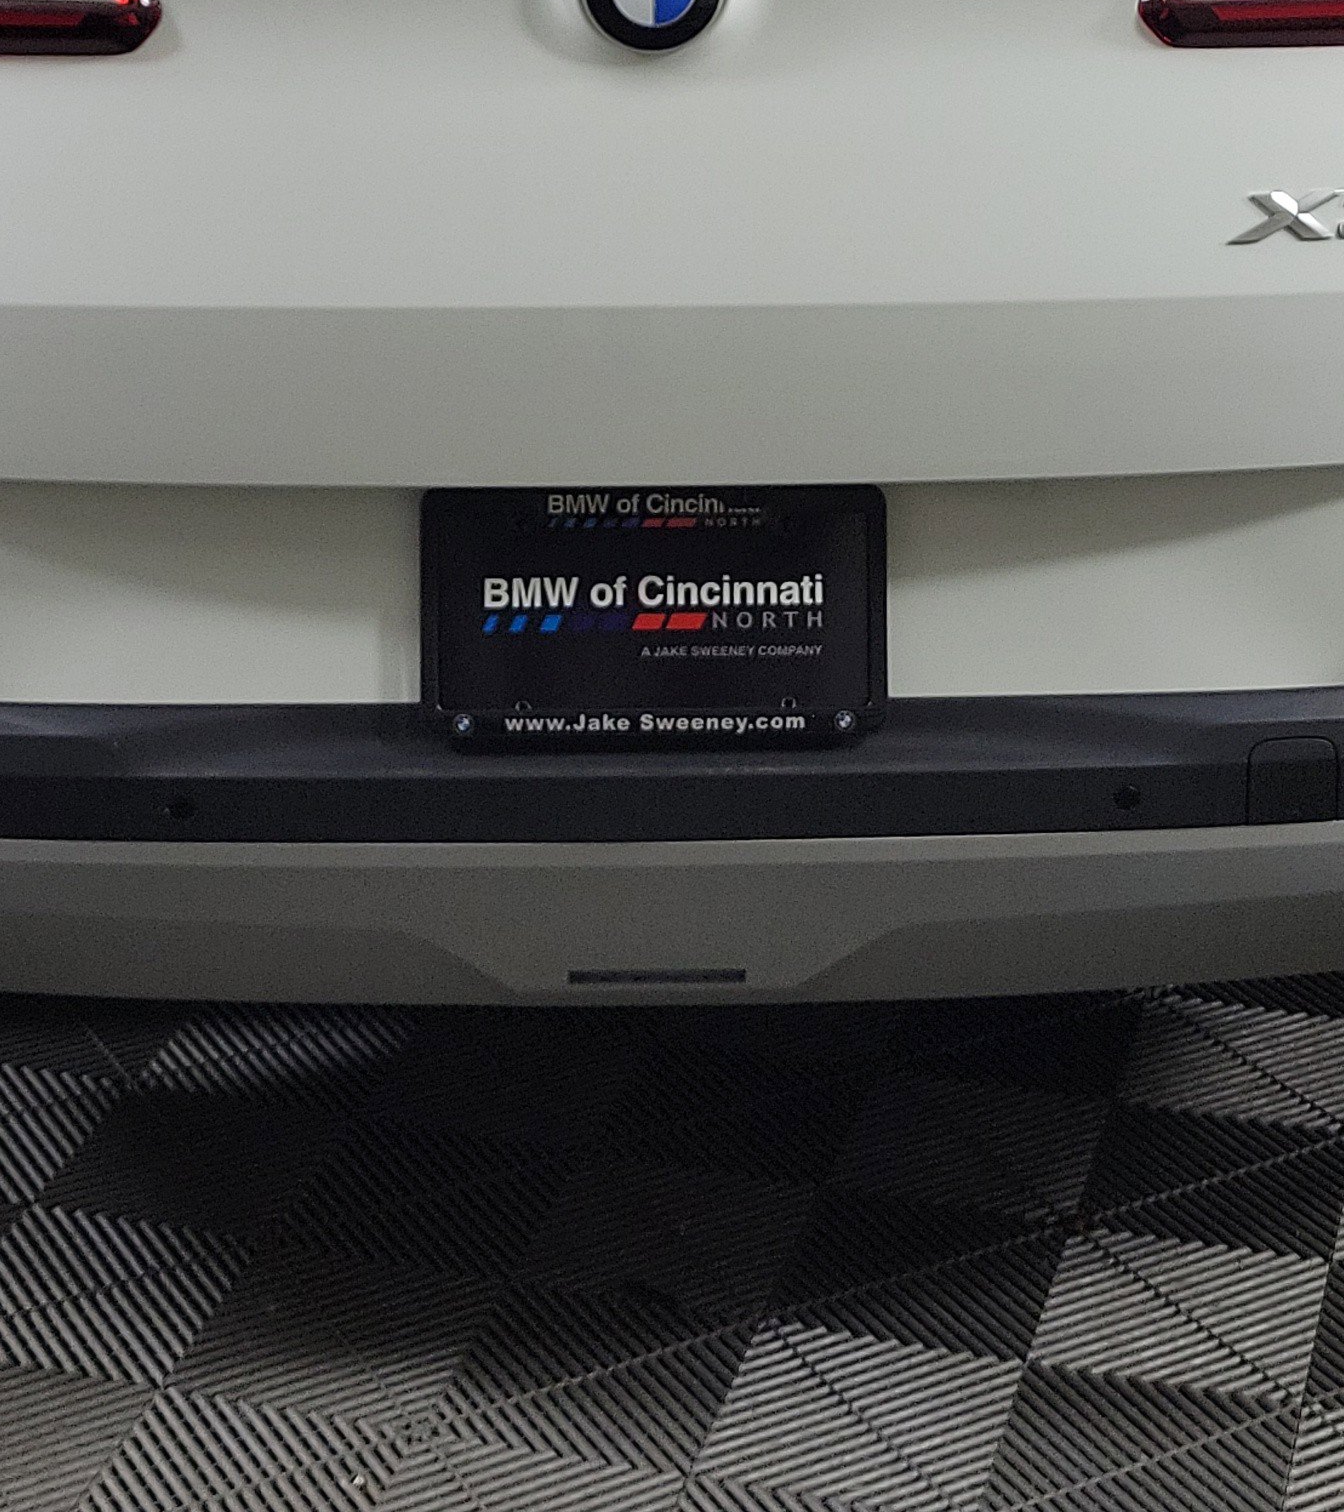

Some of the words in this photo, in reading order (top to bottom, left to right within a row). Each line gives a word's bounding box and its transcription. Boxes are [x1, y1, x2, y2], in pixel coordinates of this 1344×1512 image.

[547, 494, 610, 514] BMW
[617, 493, 640, 514] of
[646, 492, 761, 514] Cincin
[483, 577, 578, 608] BMW
[590, 576, 627, 607] of
[637, 574, 824, 607] Cincinnati
[711, 611, 823, 628] NORTH
[641, 647, 651, 657] A
[654, 646, 688, 657] JAKE
[690, 646, 755, 657] SWEENEY
[757, 645, 823, 656] COMPANY
[504, 714, 631, 732] www.Jake
[639, 714, 806, 734] Sweeney.com
